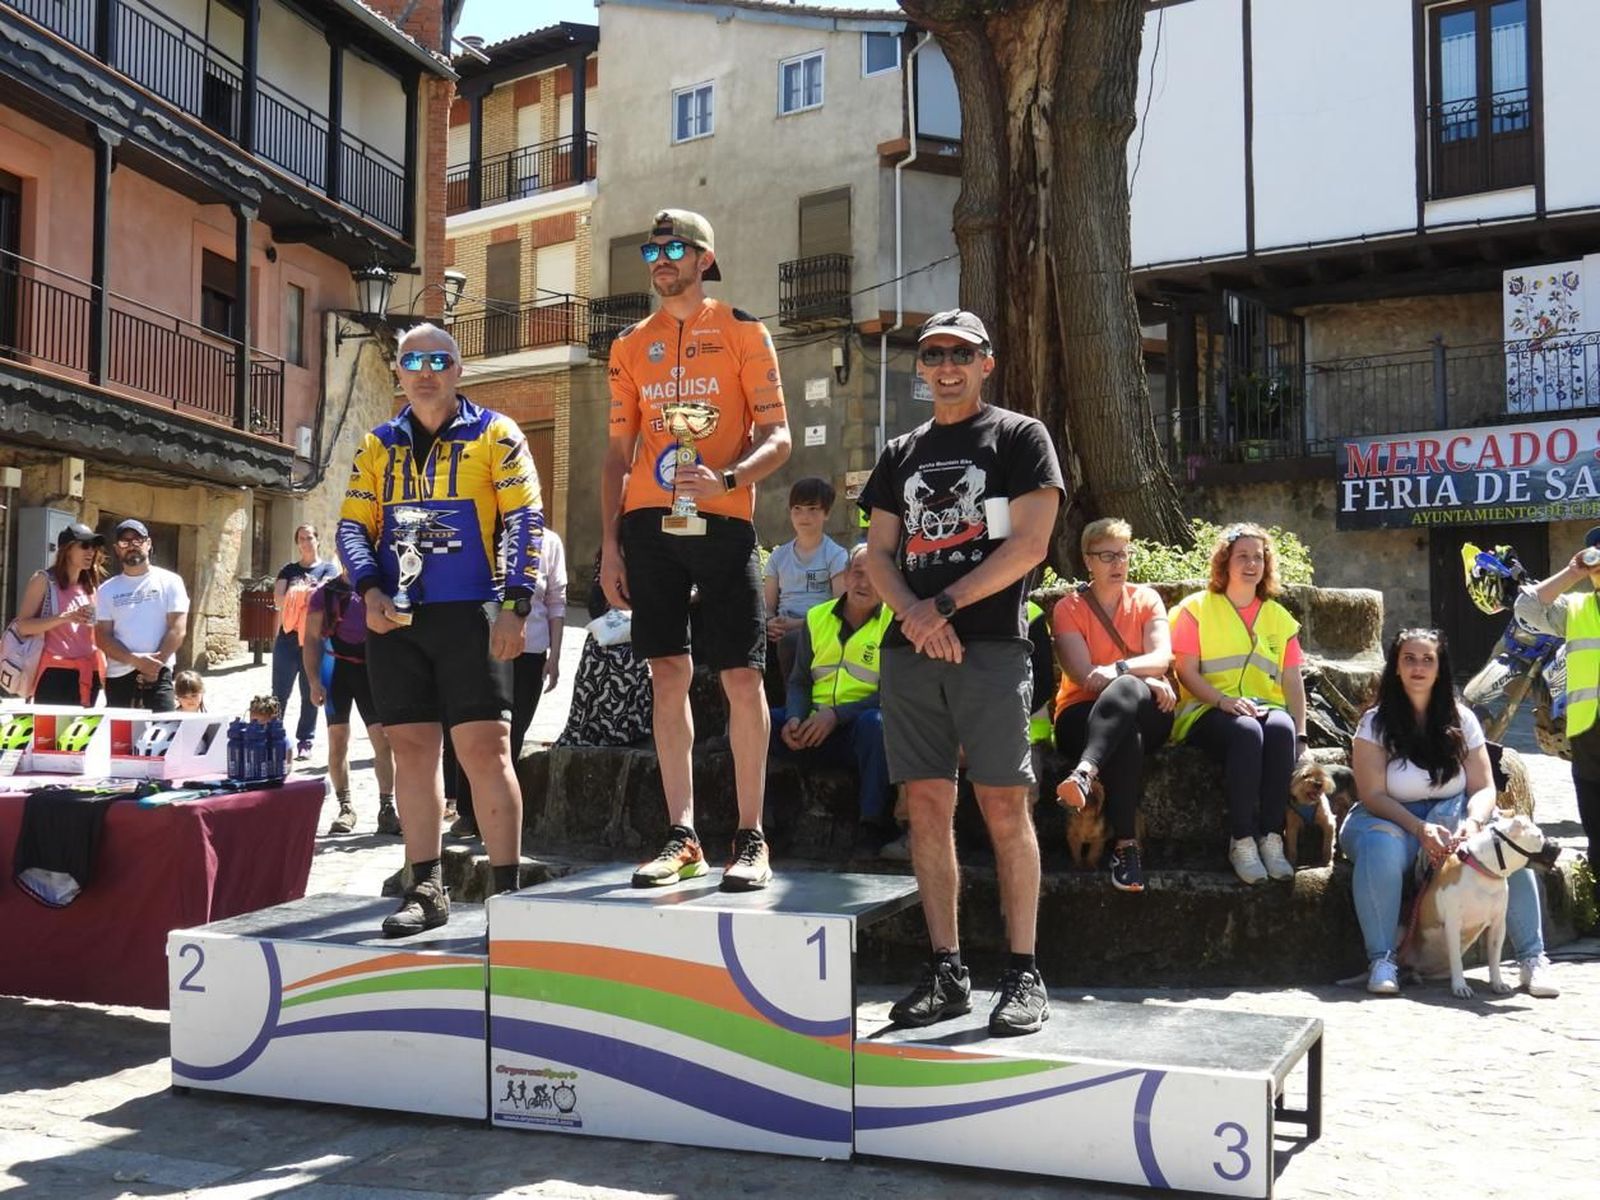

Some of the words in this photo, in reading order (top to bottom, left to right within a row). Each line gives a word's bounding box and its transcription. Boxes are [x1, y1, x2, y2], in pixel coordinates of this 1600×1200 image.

[641, 377, 720, 401] MAGUISA
[1344, 428, 1578, 479] MERCADO
[1341, 475, 1462, 512] FERIA
[1474, 470, 1531, 505] DE
[1412, 505, 1538, 525] AYUNTAMIENTO
[1545, 503, 1567, 517] DE
[179, 943, 206, 993] 2
[806, 926, 827, 981] 1
[1213, 1122, 1251, 1181] 3
